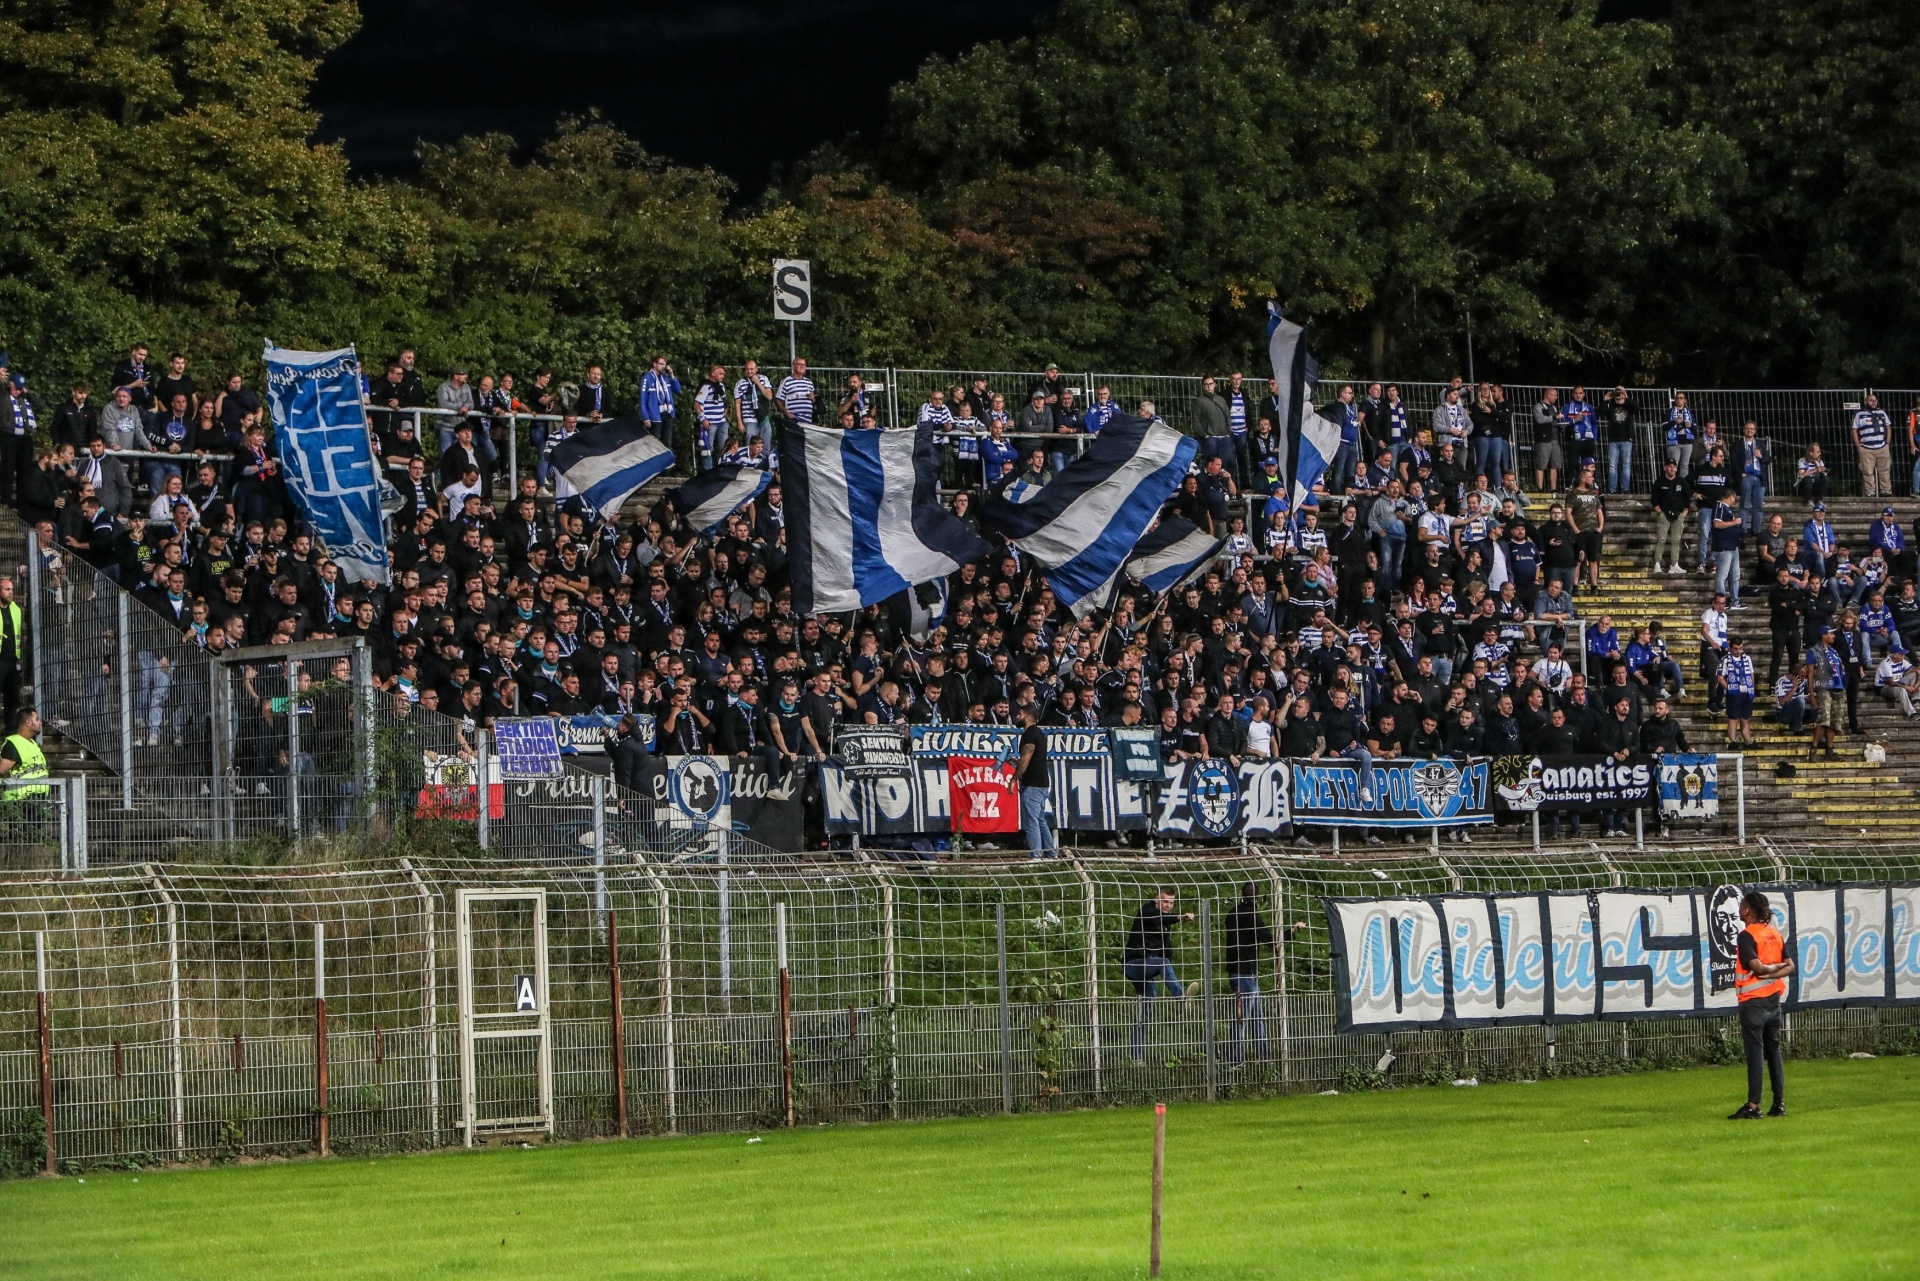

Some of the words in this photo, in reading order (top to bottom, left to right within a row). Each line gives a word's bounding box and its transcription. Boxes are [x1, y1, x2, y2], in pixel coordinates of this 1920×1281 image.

[776, 265, 810, 316] S
[496, 720, 554, 738] SEKTION
[498, 737, 559, 755] STADION
[500, 754, 560, 773] VERBOT
[1596, 791, 1617, 799] est.
[1621, 787, 1649, 799] 1997
[969, 792, 1000, 818] MZ
[1711, 961, 1729, 971] Dieter
[517, 977, 536, 1010] A
